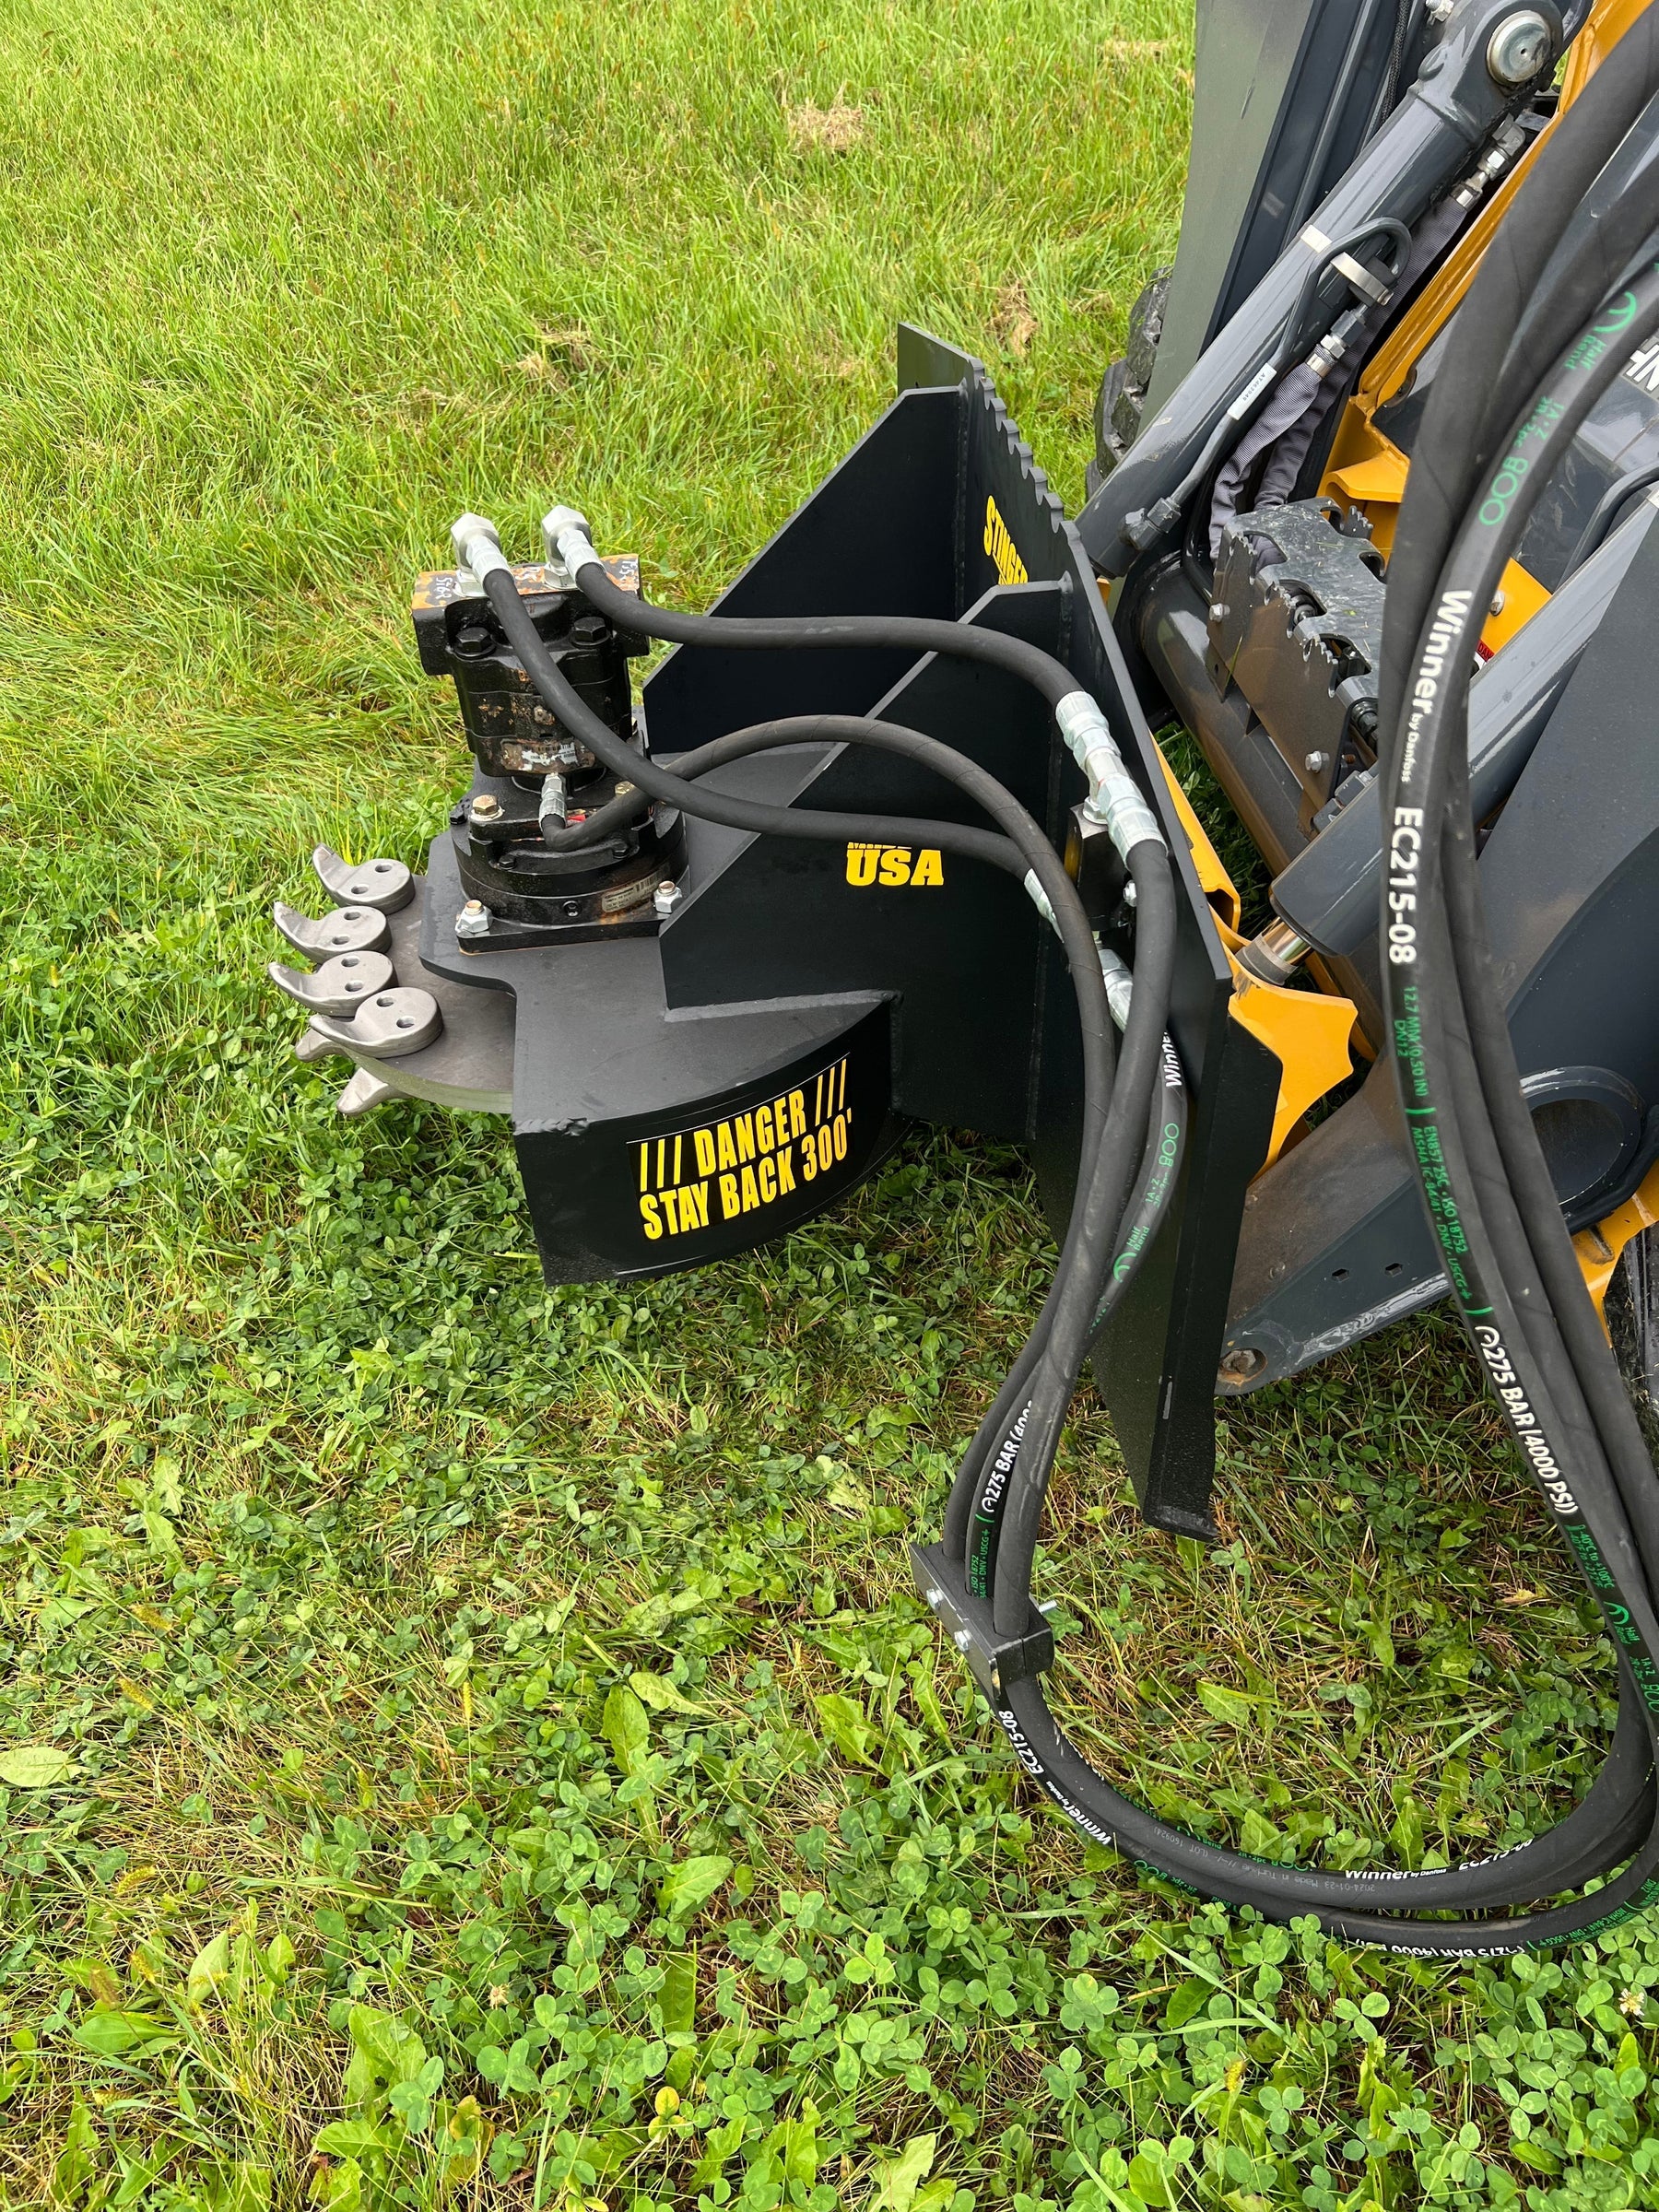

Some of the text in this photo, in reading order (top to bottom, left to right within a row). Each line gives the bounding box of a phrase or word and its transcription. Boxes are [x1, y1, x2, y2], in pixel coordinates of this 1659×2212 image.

[1401, 590, 1473, 783] Winner by Danfoss
[846, 849, 945, 886] USA
[1388, 806, 1424, 964] EC215-08
[693, 1089, 807, 1178] DANGER
[640, 1107, 852, 1240] STAY BACK 300'
[1482, 1347, 1516, 1383] 275
[1500, 1386, 1535, 1429] BAR
[994, 1440, 1020, 1473] BAR
[1517, 1429, 1560, 1479] (4000
[984, 1470, 1006, 1500] 275
[998, 1710, 1044, 1774] EC215-08
[1063, 1805, 1112, 1845] Winner
[1345, 1869, 1411, 1880] Winner
